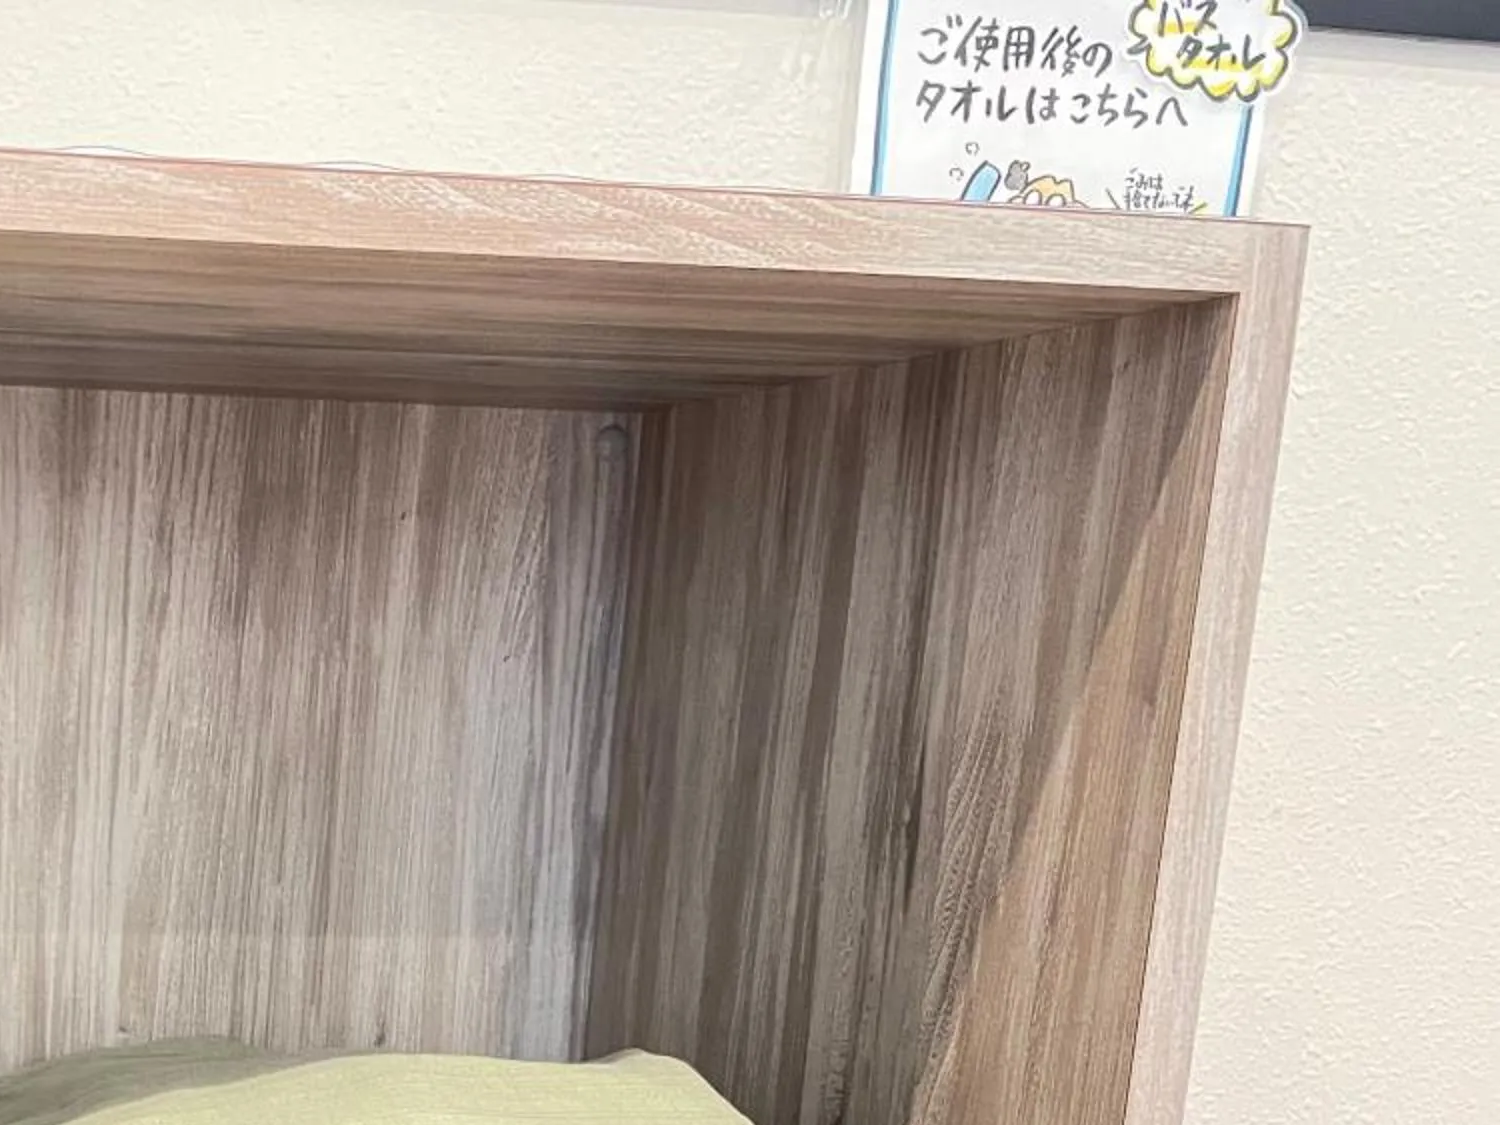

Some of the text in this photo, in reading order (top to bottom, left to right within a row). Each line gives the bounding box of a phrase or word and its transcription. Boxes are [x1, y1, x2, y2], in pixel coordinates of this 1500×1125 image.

[918, 15, 1113, 78] ご使用後の
[1176, 33, 1266, 70] タオル
[915, 80, 1189, 129] タオルはこちらへ
